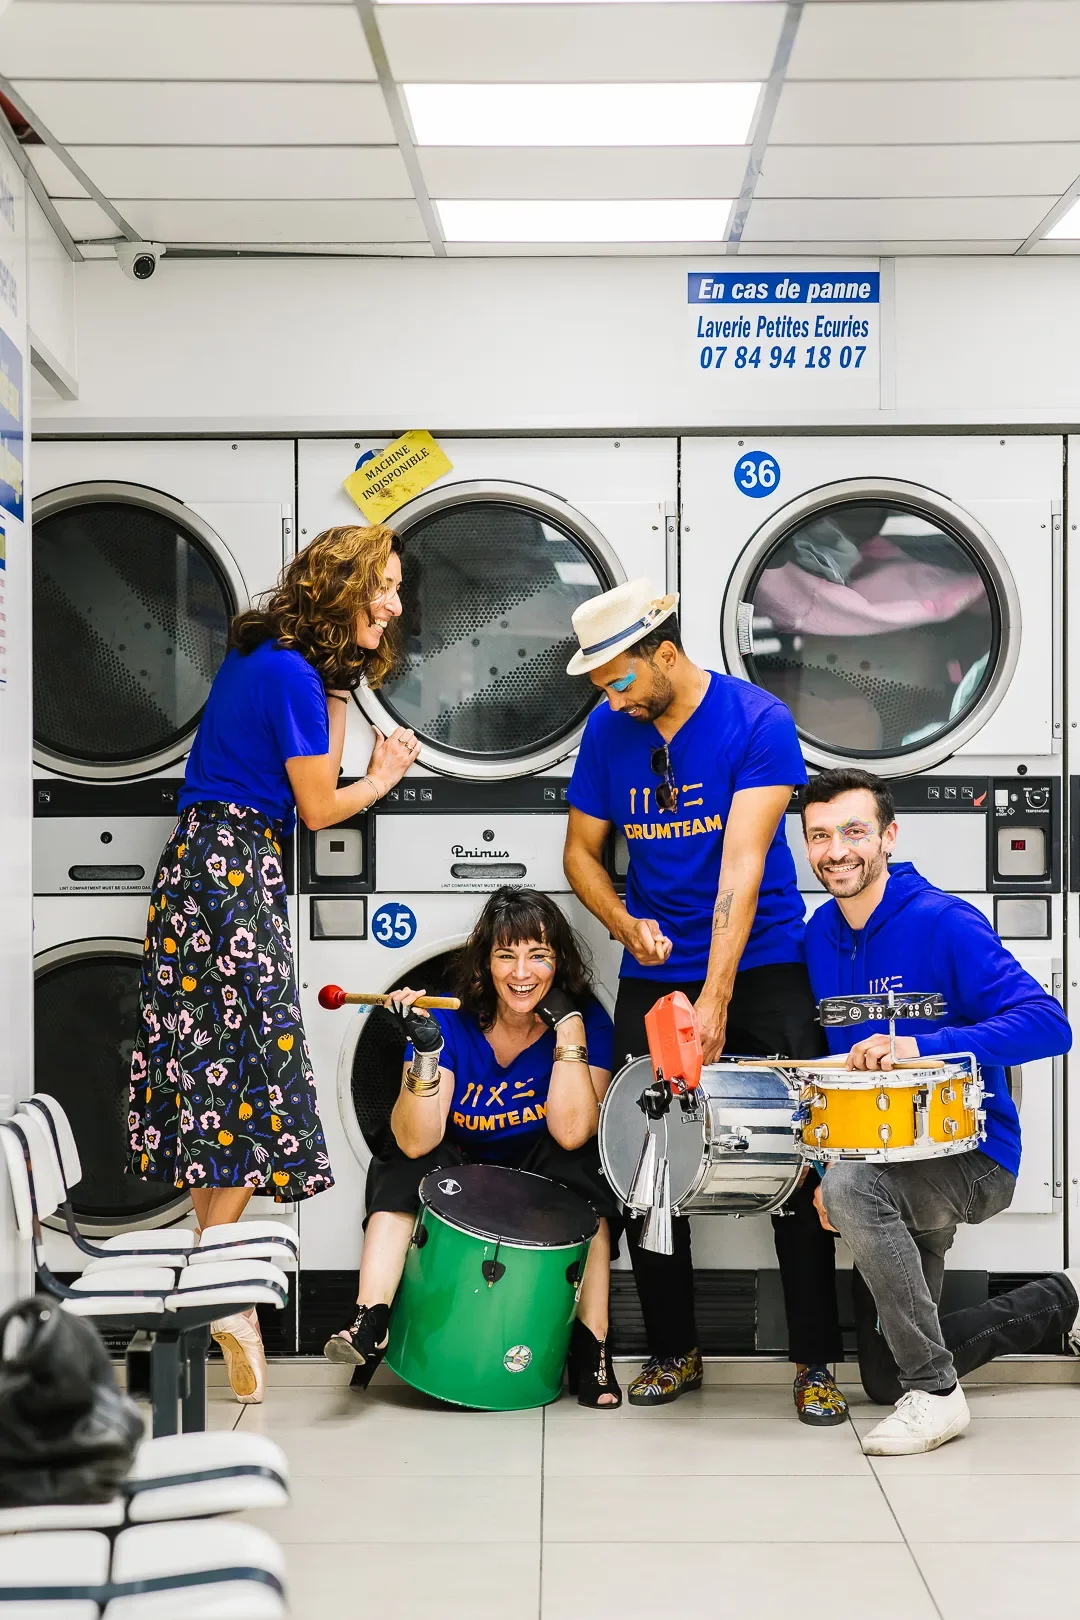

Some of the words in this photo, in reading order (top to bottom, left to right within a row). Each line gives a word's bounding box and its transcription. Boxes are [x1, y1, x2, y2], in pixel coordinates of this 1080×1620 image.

[698, 278, 724, 299] En
[731, 283, 768, 300] cas
[775, 278, 800, 299] de
[806, 282, 871, 303] panne
[697, 315, 751, 338] Laverie
[756, 315, 810, 338] Petites
[814, 314, 869, 338] Ecuries
[700, 346, 727, 368] 07
[734, 346, 761, 368] 84
[769, 346, 796, 368] 94
[804, 346, 831, 368] 18
[839, 346, 867, 368] 07
[361, 447, 430, 500] INDISPONIBLE
[364, 444, 411, 481] MACHINE
[740, 459, 776, 489] 36
[623, 814, 723, 840] DRUMTEAM
[451, 845, 510, 858] Primus
[376, 912, 412, 941] 35
